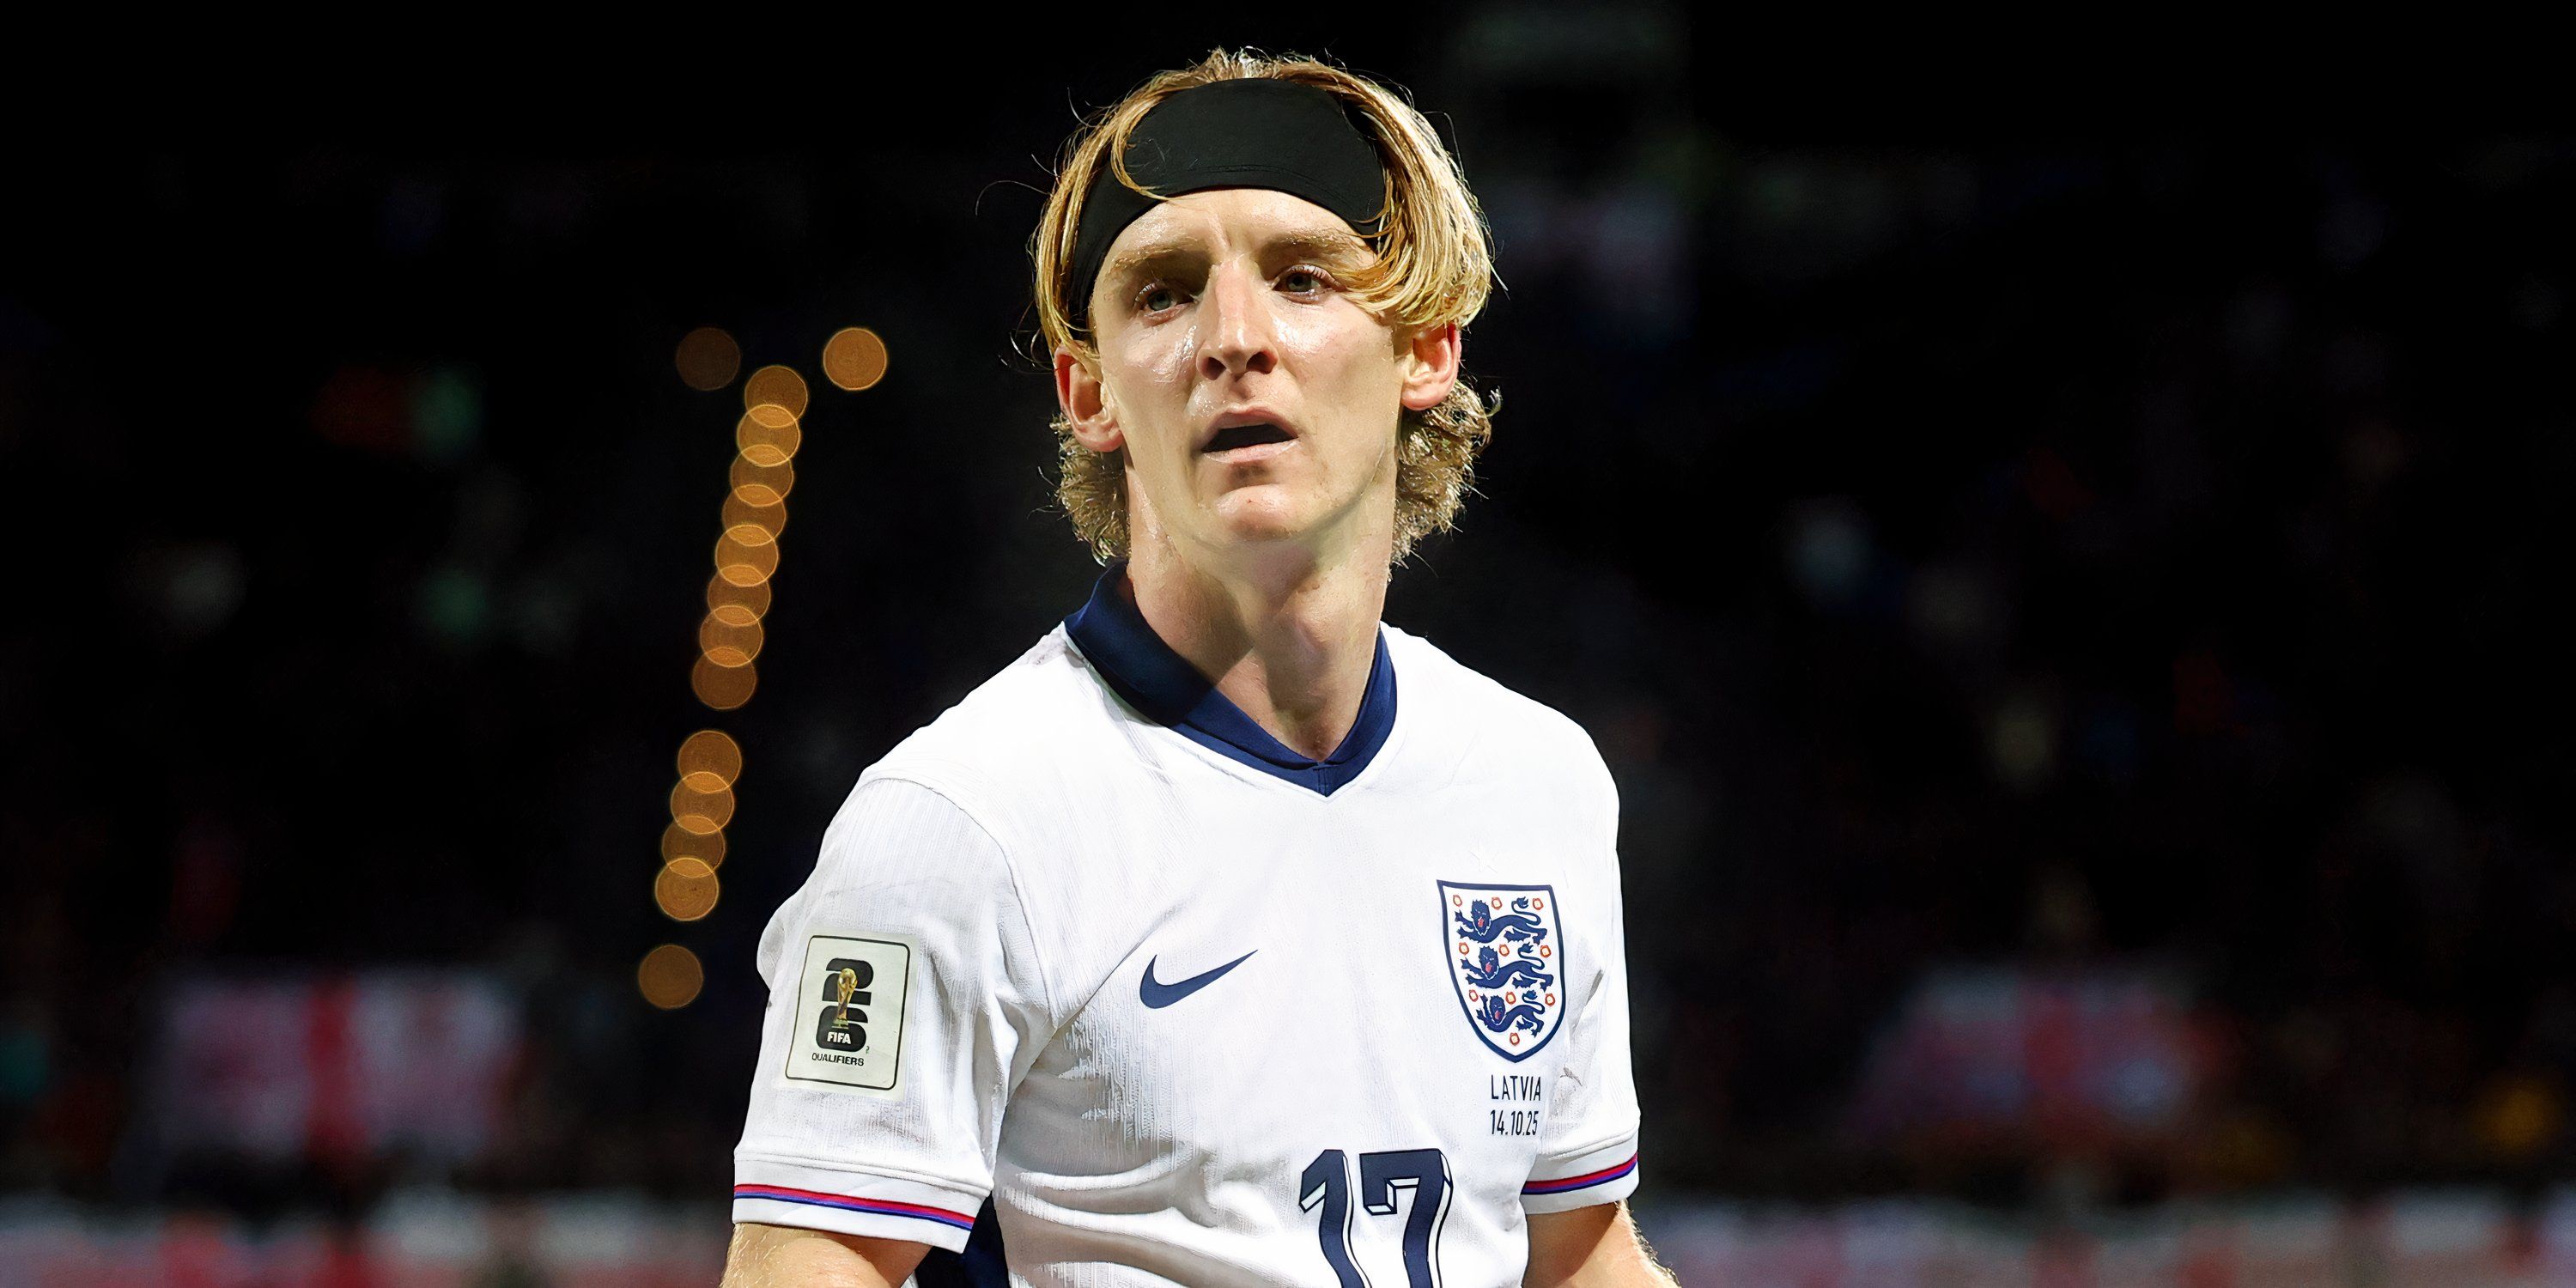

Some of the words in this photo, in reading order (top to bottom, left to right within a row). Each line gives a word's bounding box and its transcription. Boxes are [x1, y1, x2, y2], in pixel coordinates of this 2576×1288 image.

[827, 1031, 852, 1045] FIFA
[811, 1052, 865, 1066] QUALIFIERS
[1491, 1074, 1541, 1101] LATVIA
[1490, 1109, 1540, 1136] 14.10.25
[1298, 1148, 1454, 1288] 17
